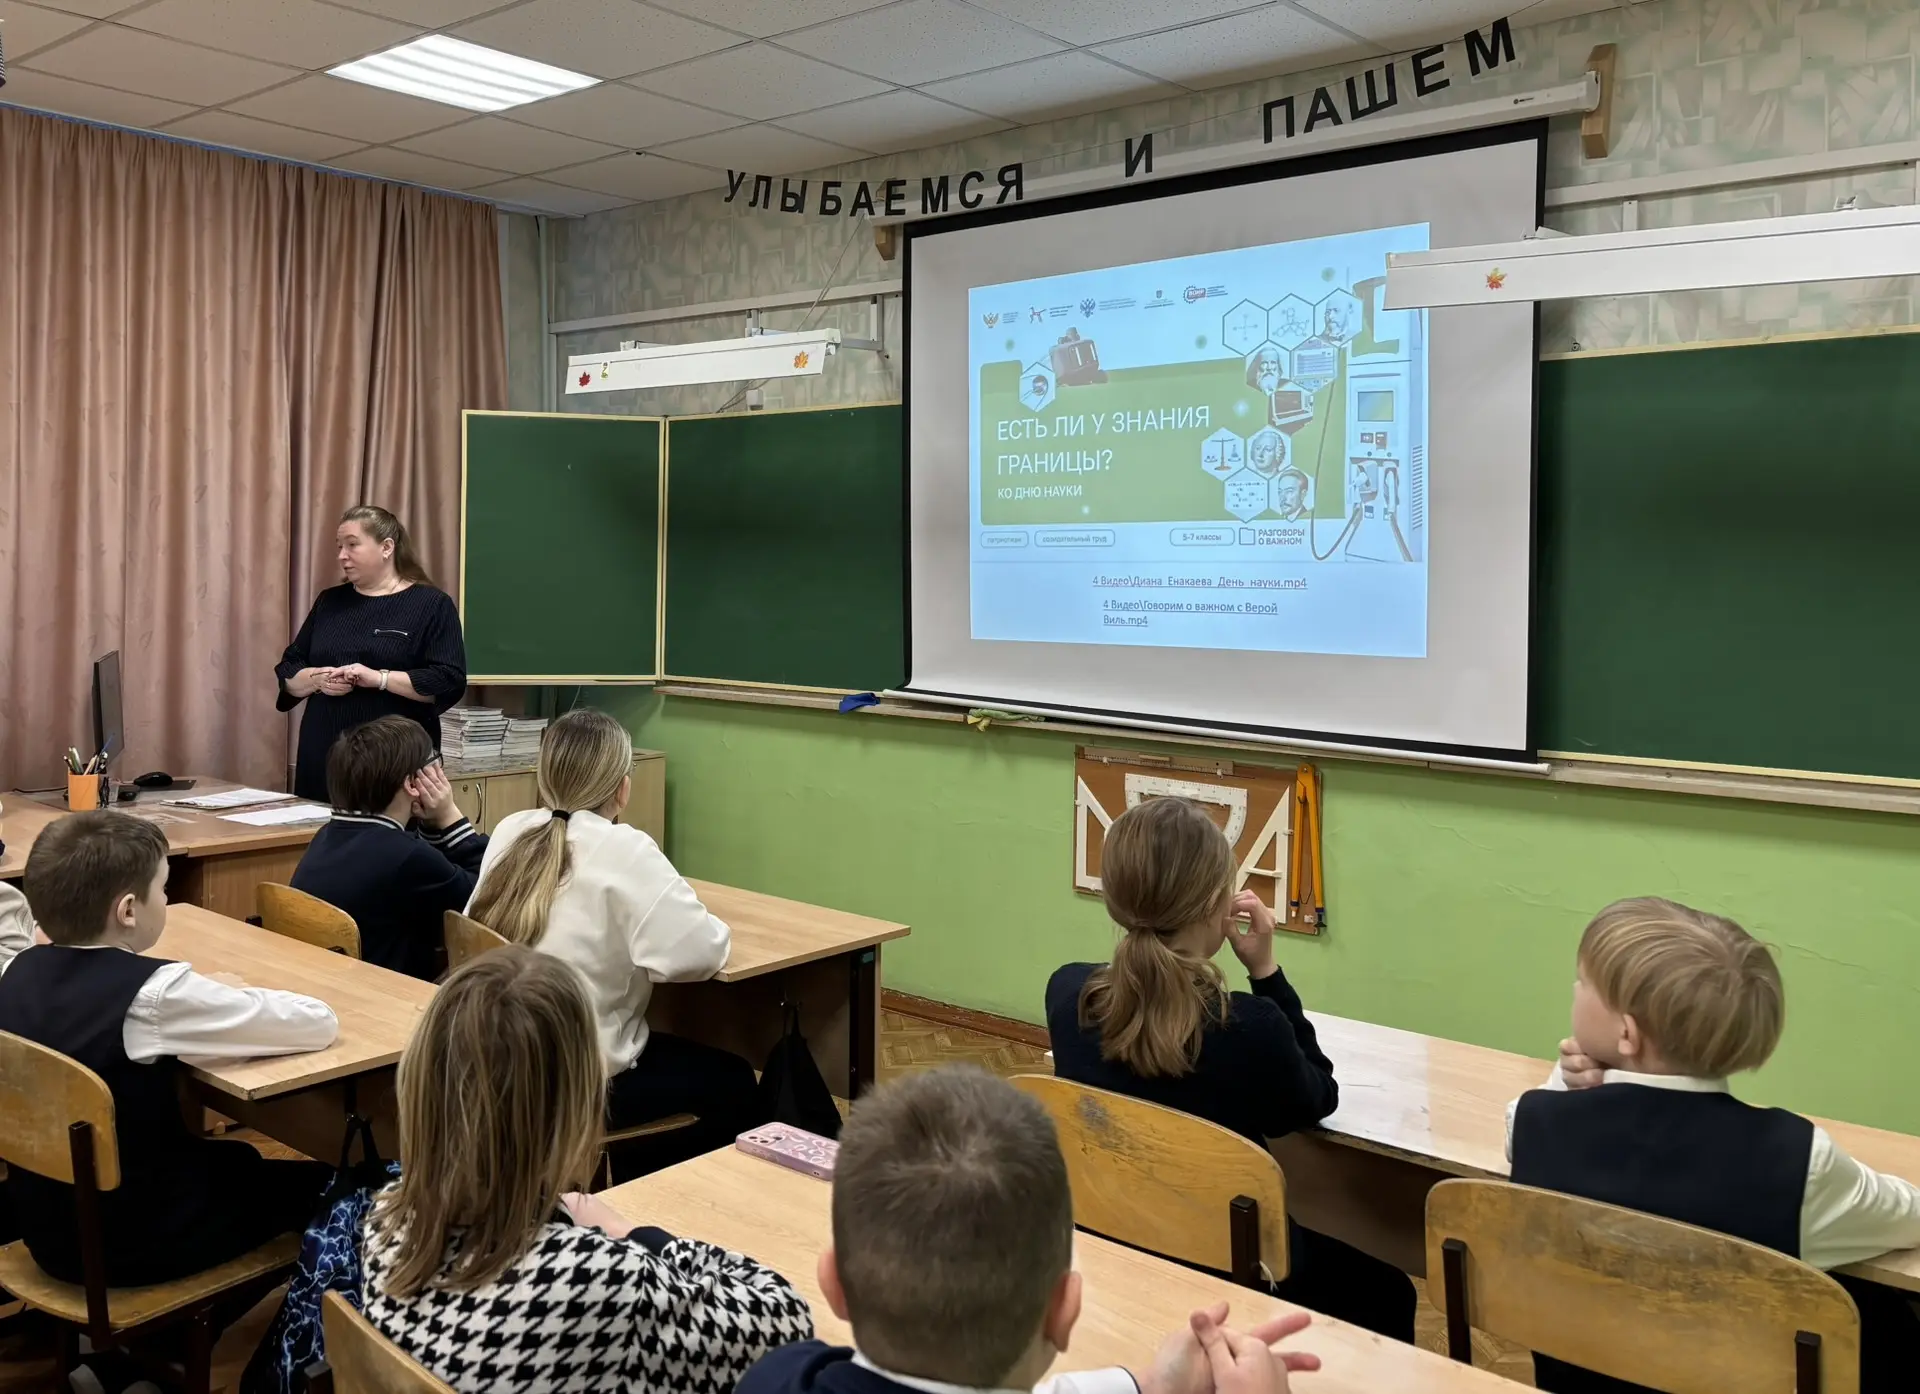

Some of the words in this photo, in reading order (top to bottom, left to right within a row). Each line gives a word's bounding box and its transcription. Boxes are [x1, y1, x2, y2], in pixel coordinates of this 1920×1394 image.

[724, 163, 1024, 217] УЛЫБАЕМСЯ
[1125, 134, 1153, 178] И
[1263, 16, 1516, 144] ПАШЕМ
[997, 418, 1048, 441] ЕСТЬ
[1053, 414, 1084, 437] ЛИ
[1091, 413, 1105, 434] У
[1111, 405, 1210, 433] ЗНАНИЯ
[997, 449, 1113, 475] ГРАНИЦЫ?
[998, 488, 1012, 499] КО
[1015, 486, 1041, 500] ДНЮ
[1044, 485, 1083, 498] НАУКИ
[1182, 533, 1194, 541] 5-7
[1196, 533, 1222, 541] классы
[1258, 529, 1305, 537] РАЗГОВОРЫ
[1258, 537, 1265, 545] О
[1266, 537, 1302, 545] ВАЖНОМ
[1092, 576, 1099, 585] 4
[1168, 576, 1212, 587] Енакаева
[1217, 576, 1245, 588] День
[1250, 577, 1308, 589] науки.mp4
[1103, 600, 1109, 609] 4
[1111, 599, 1184, 612] Видео\Говорим
[1195, 603, 1235, 612] важном
[1237, 604, 1243, 612] с
[1245, 602, 1278, 614] Верой
[1103, 615, 1148, 626] Виль.mp4
